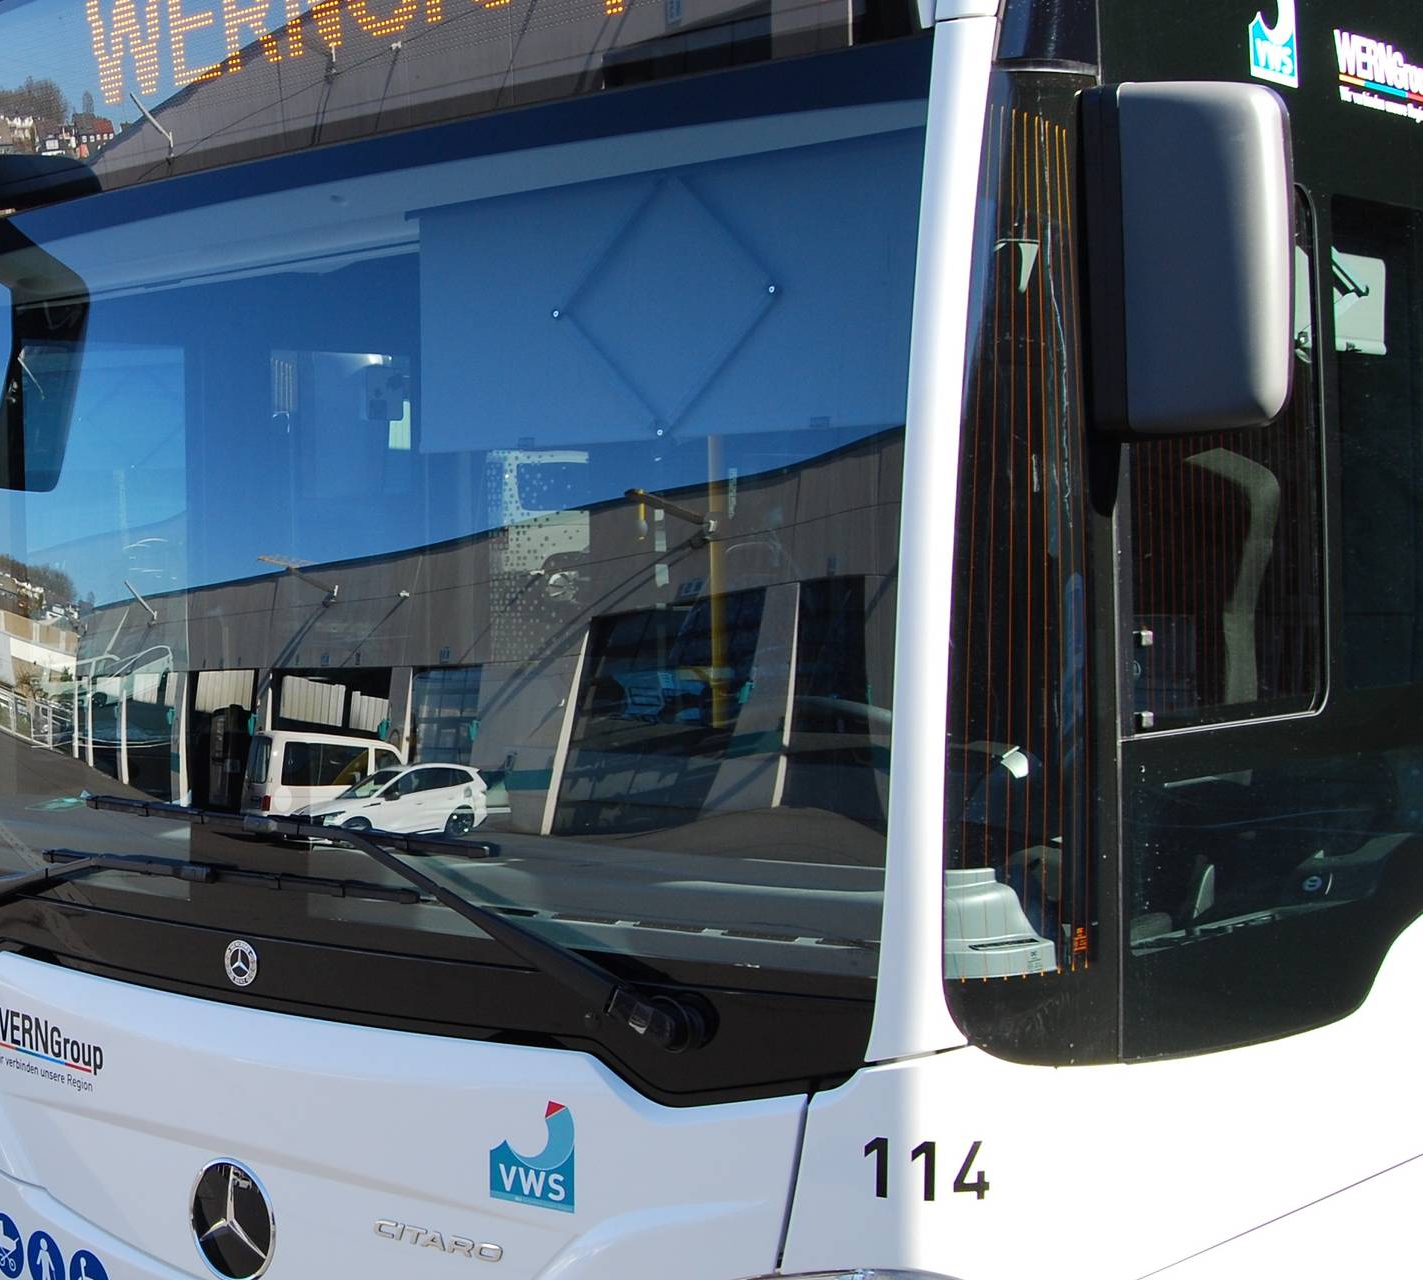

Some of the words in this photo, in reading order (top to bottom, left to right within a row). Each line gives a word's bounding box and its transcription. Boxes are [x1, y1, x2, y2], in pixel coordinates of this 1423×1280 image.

[5, 1057, 39, 1076] verbinden
[40, 1068, 65, 1084] unsere
[66, 1073, 94, 1092] Region
[498, 1162, 566, 1202] VWS
[863, 1136, 991, 1202] 114
[373, 1218, 504, 1263] CITARO
